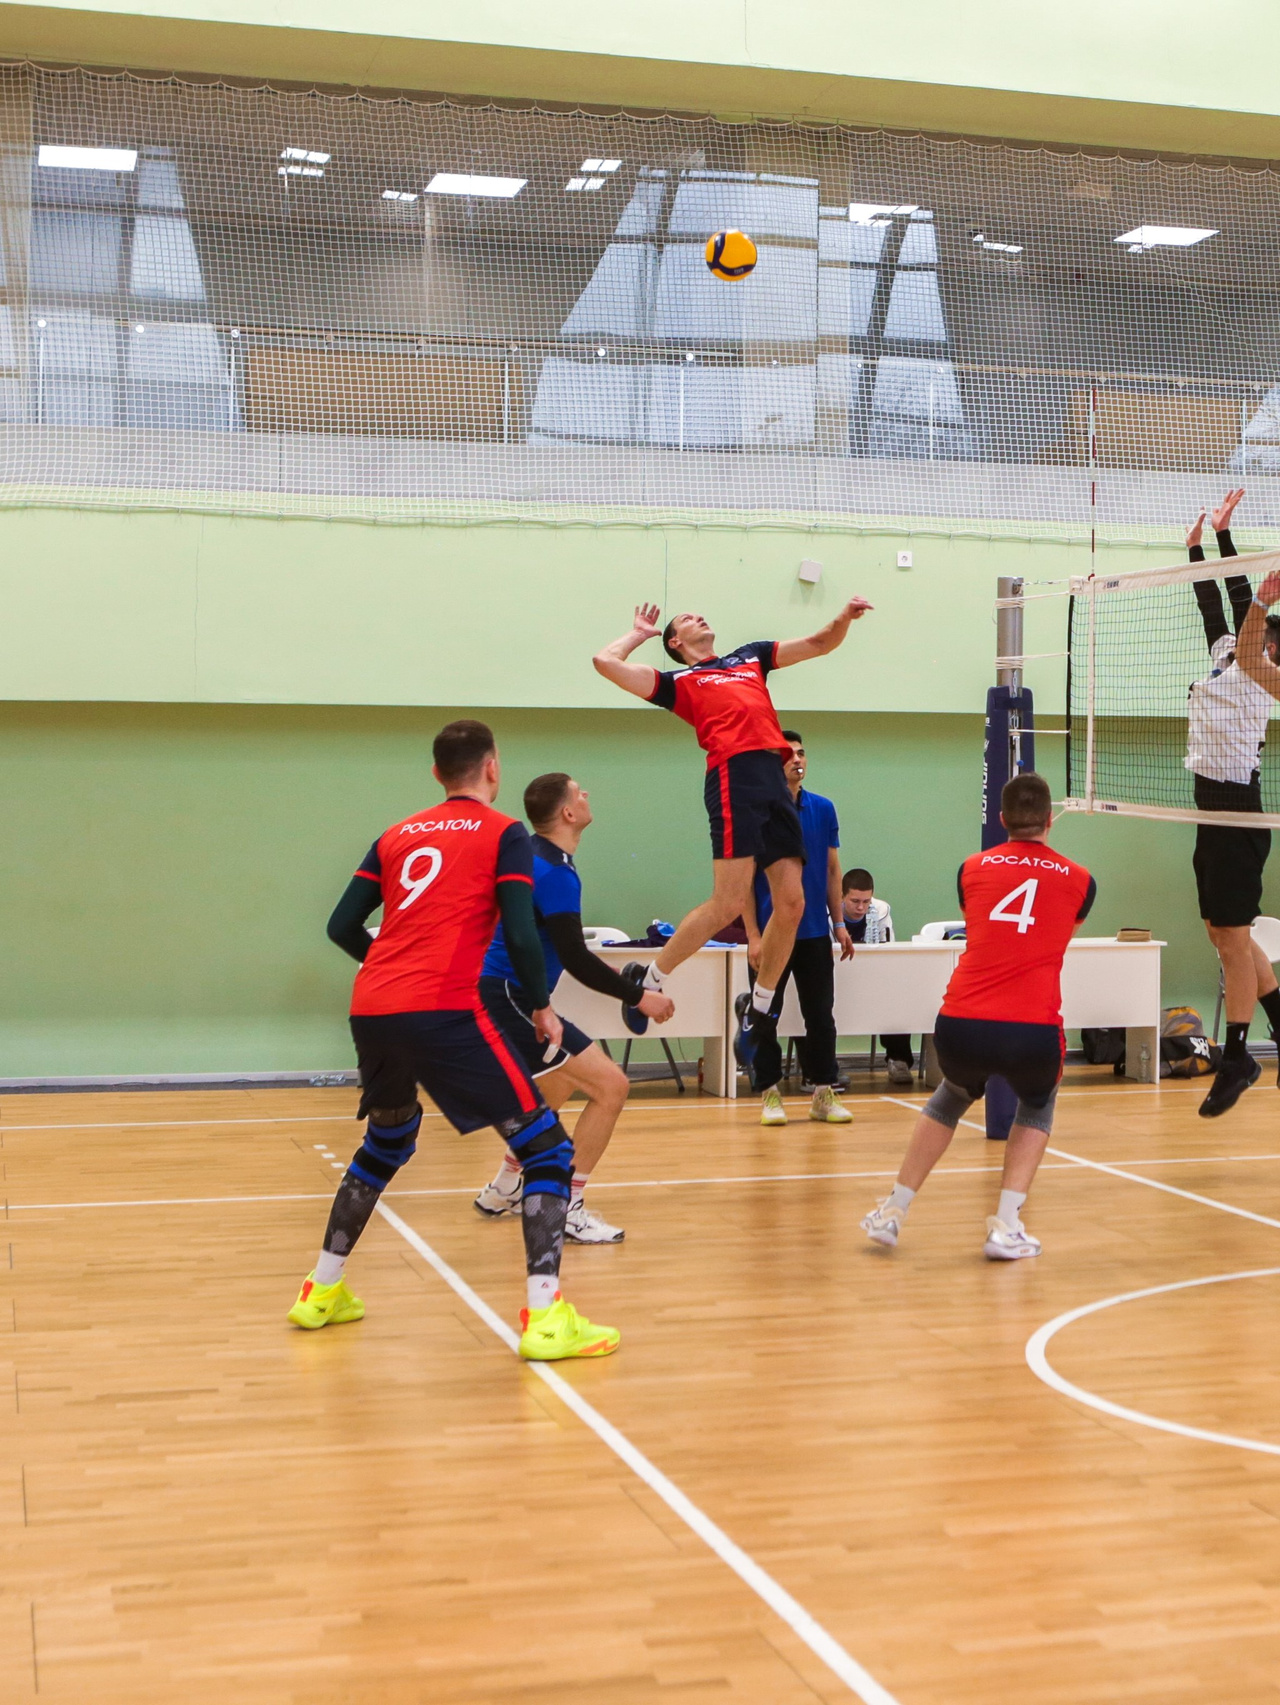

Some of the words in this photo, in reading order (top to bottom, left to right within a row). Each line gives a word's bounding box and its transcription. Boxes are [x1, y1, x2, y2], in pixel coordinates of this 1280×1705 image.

[399, 818, 482, 835] РОСАТОМ
[397, 846, 443, 910] 9
[981, 854, 1070, 876] РОСАТОМ
[989, 878, 1039, 934] 4
